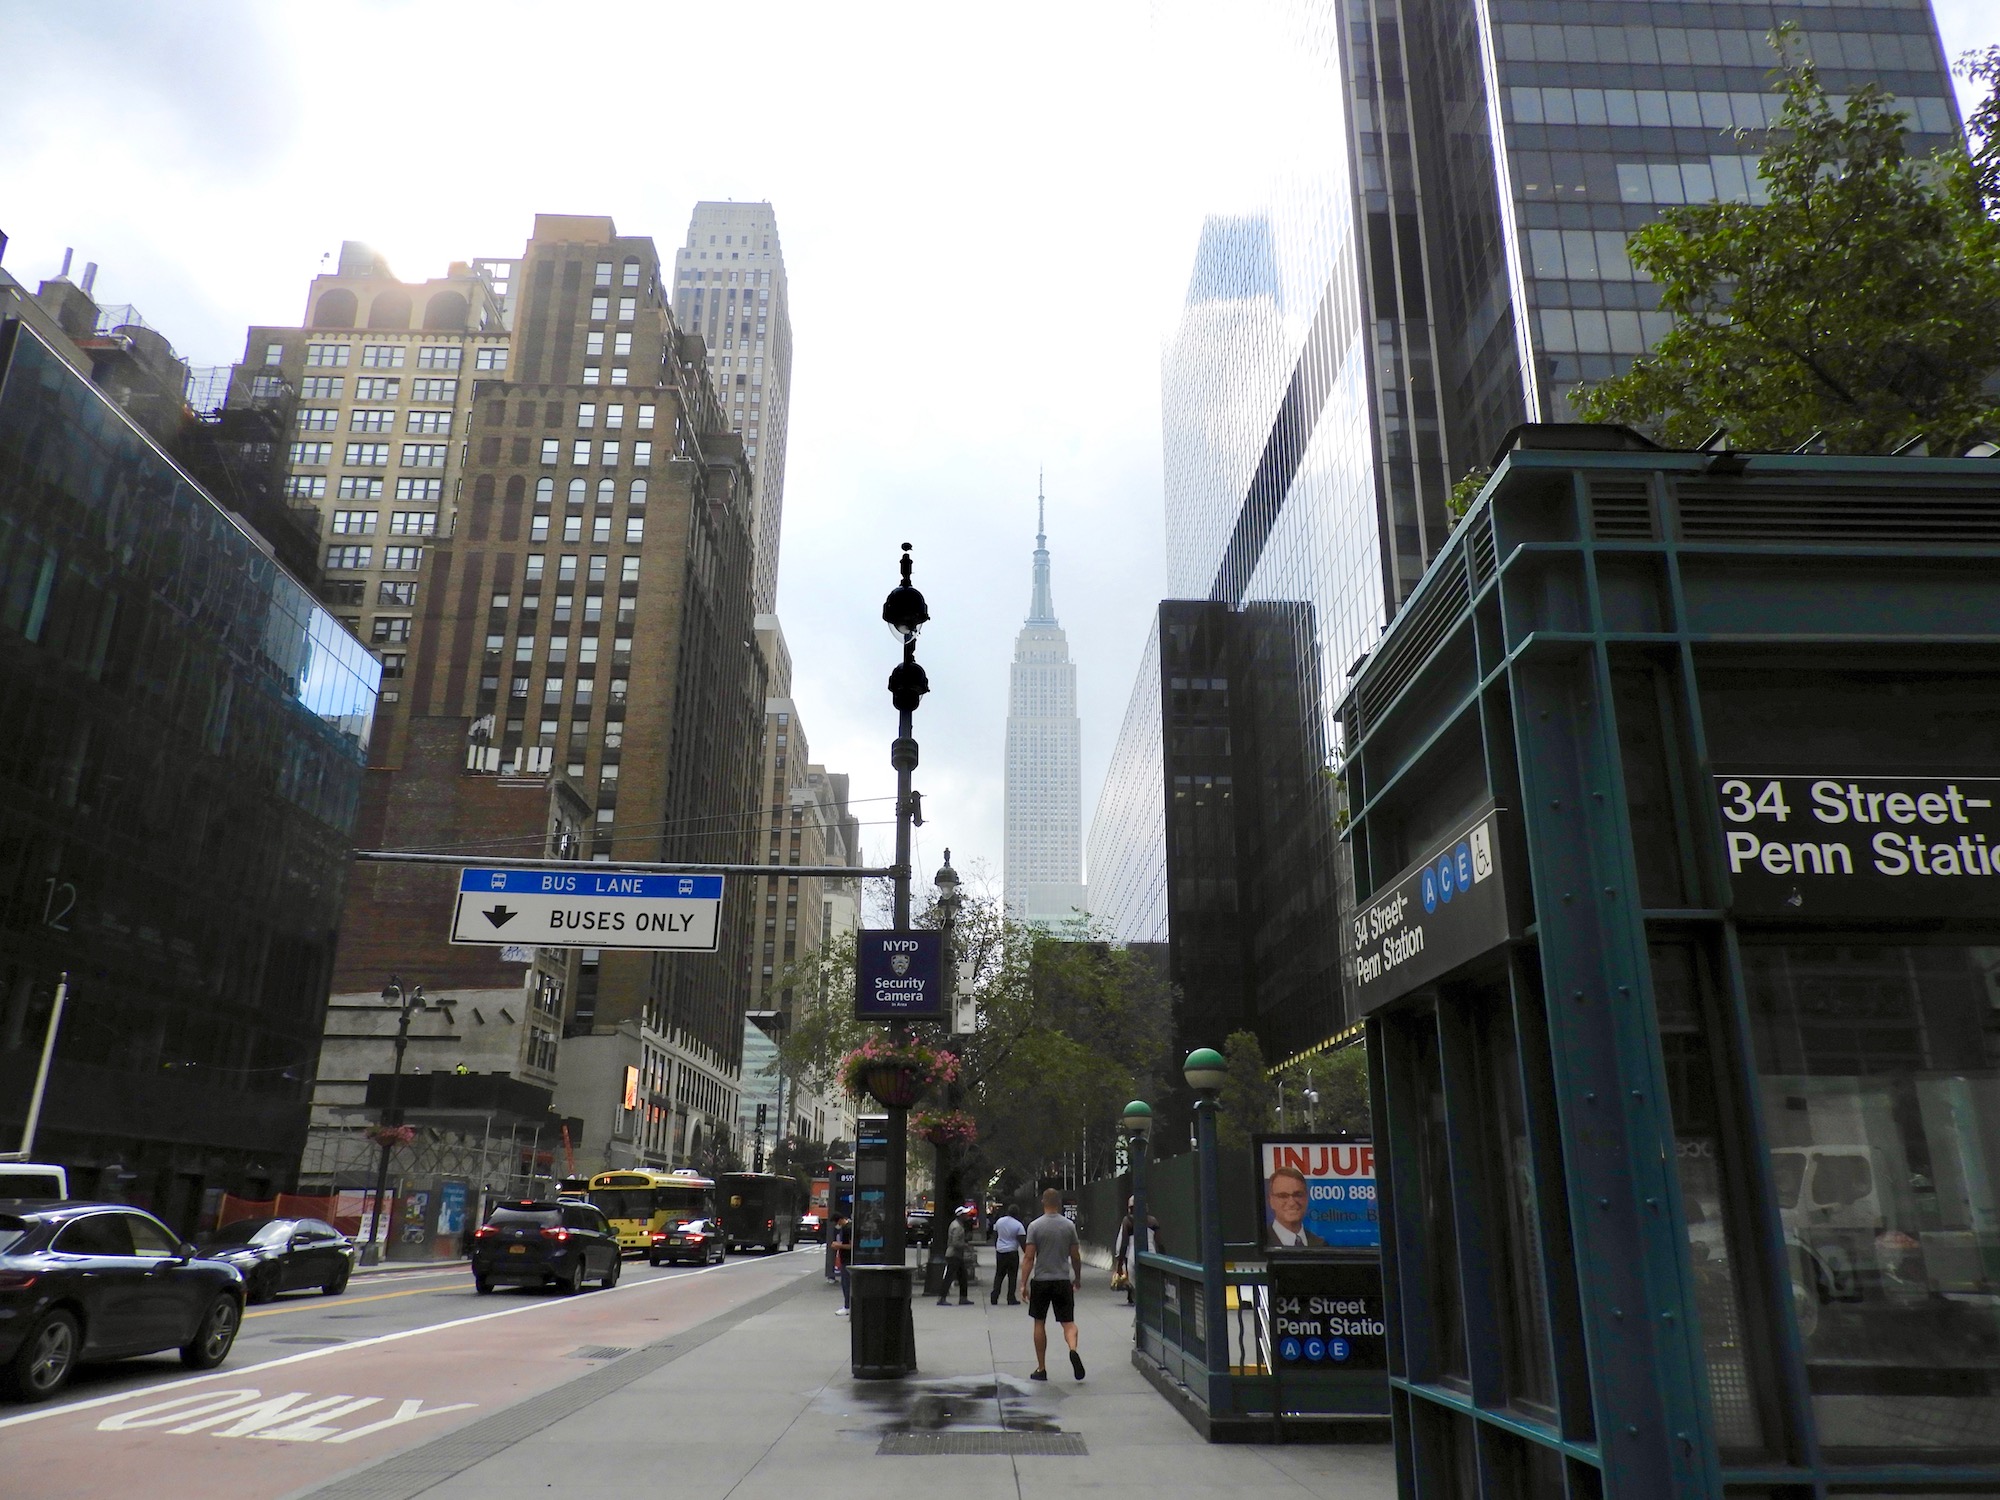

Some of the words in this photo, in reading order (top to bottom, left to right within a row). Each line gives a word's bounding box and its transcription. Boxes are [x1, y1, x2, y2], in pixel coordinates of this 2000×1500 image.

[1721, 780, 1791, 822] 34
[1810, 780, 1992, 824] Street-
[1726, 831, 1854, 875] Penn
[1871, 831, 2000, 876] Stati
[541, 876, 577, 891] BUS
[595, 878, 644, 894] LANE
[1426, 878, 1435, 904] A
[1441, 866, 1451, 892] C
[1457, 853, 1468, 882] E
[42, 877, 77, 932] 12
[549, 910, 626, 931] BUSES
[635, 912, 695, 932] ONLY
[1354, 916, 1369, 951] 34
[1370, 891, 1408, 940] Street-
[883, 940, 919, 952] NYPD
[1356, 952, 1382, 987] Penn
[1383, 925, 1425, 972] Station
[874, 977, 926, 991] Security
[875, 989, 924, 1002] Camera
[1309, 1185, 1345, 1201] (800)
[1309, 1208, 1358, 1222] Cellino
[1276, 1297, 1301, 1315] 34
[1309, 1297, 1366, 1315] Street
[1276, 1318, 1321, 1335] Penn
[1286, 1342, 1297, 1356] A
[1308, 1342, 1320, 1356] C
[1333, 1342, 1344, 1356] E
[96, 1388, 479, 1443] ONLY
